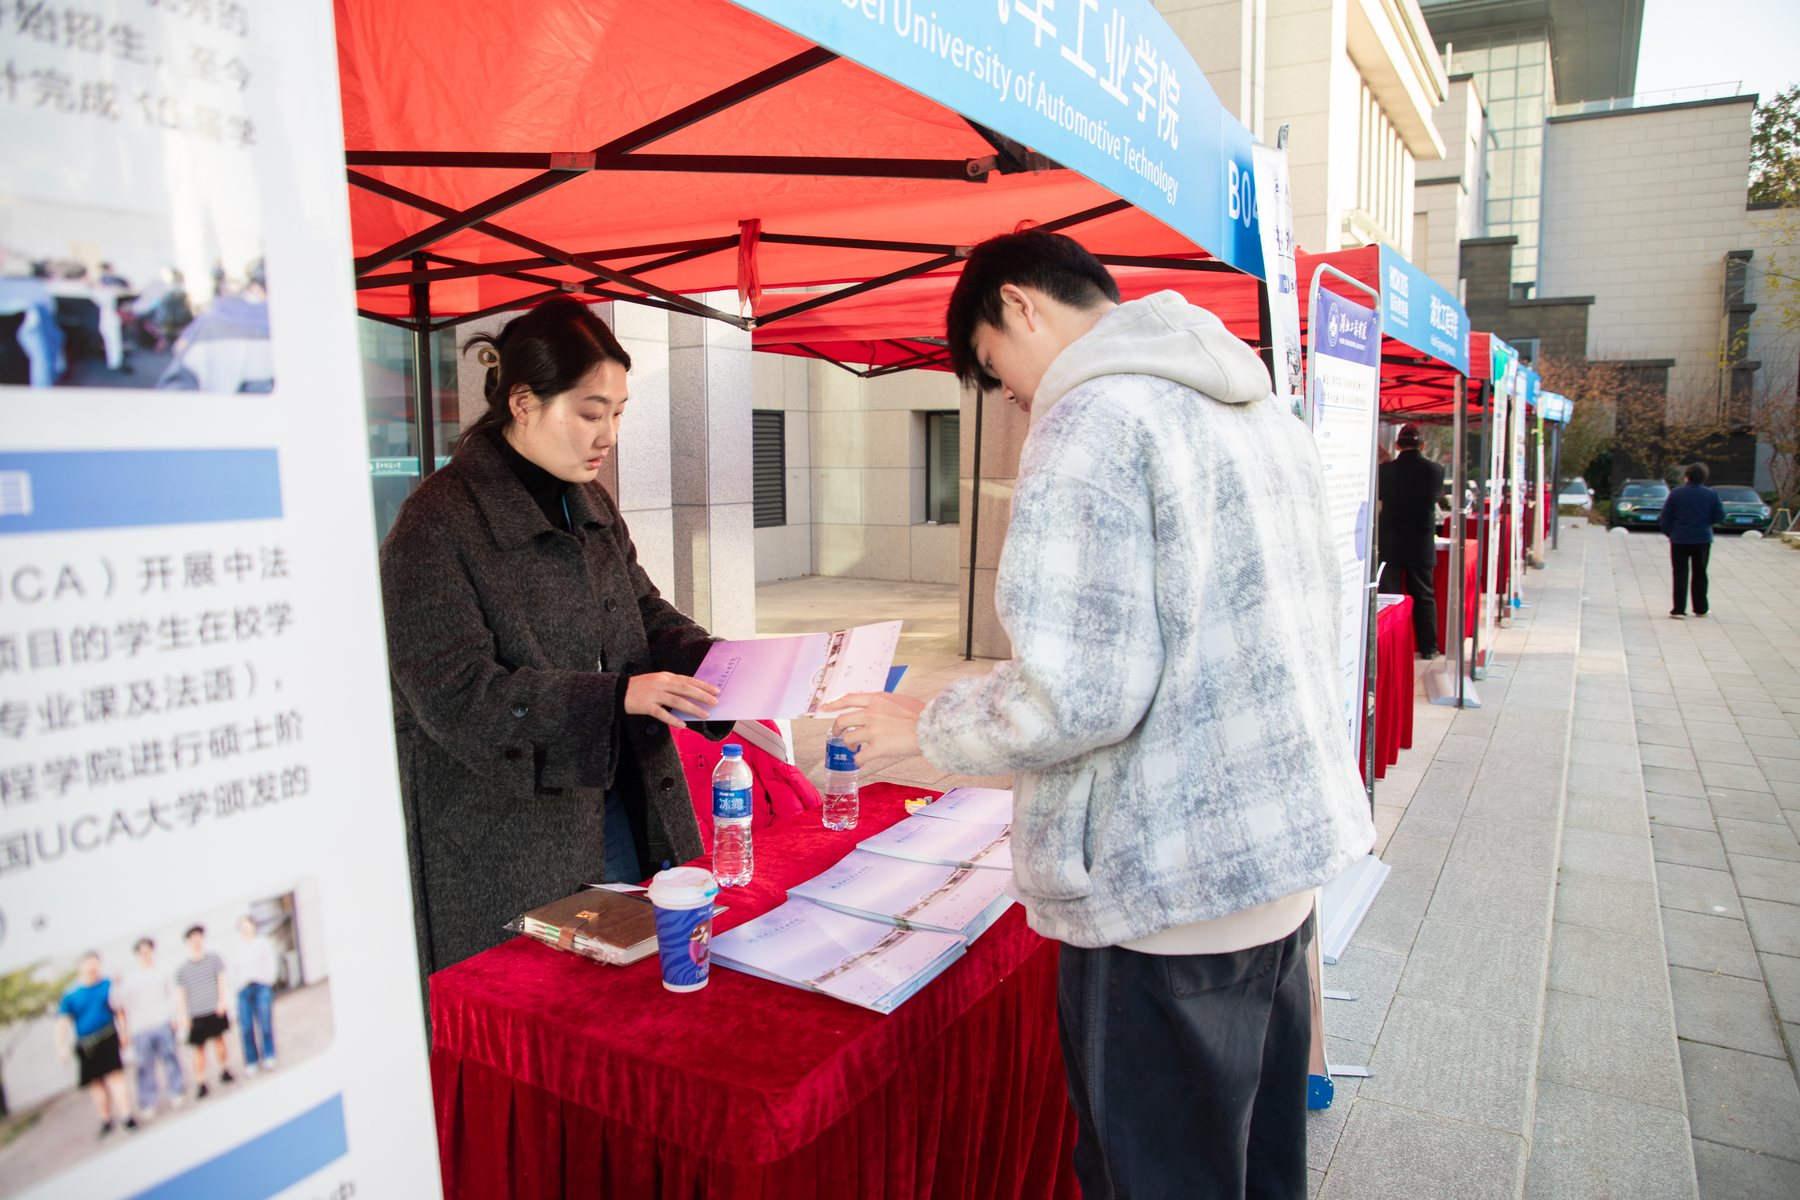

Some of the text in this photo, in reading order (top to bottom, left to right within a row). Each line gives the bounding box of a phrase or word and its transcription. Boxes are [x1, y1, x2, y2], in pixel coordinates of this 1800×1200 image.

[894, 0, 1012, 102] University
[1015, 70, 1036, 107] of
[1036, 80, 1122, 161] Automotive
[1123, 135, 1179, 206] Technology
[998, 0, 1180, 150] 车工业学院
[0, 546, 290, 605] CA）开展中法
[719, 797, 744, 811] 冰露
